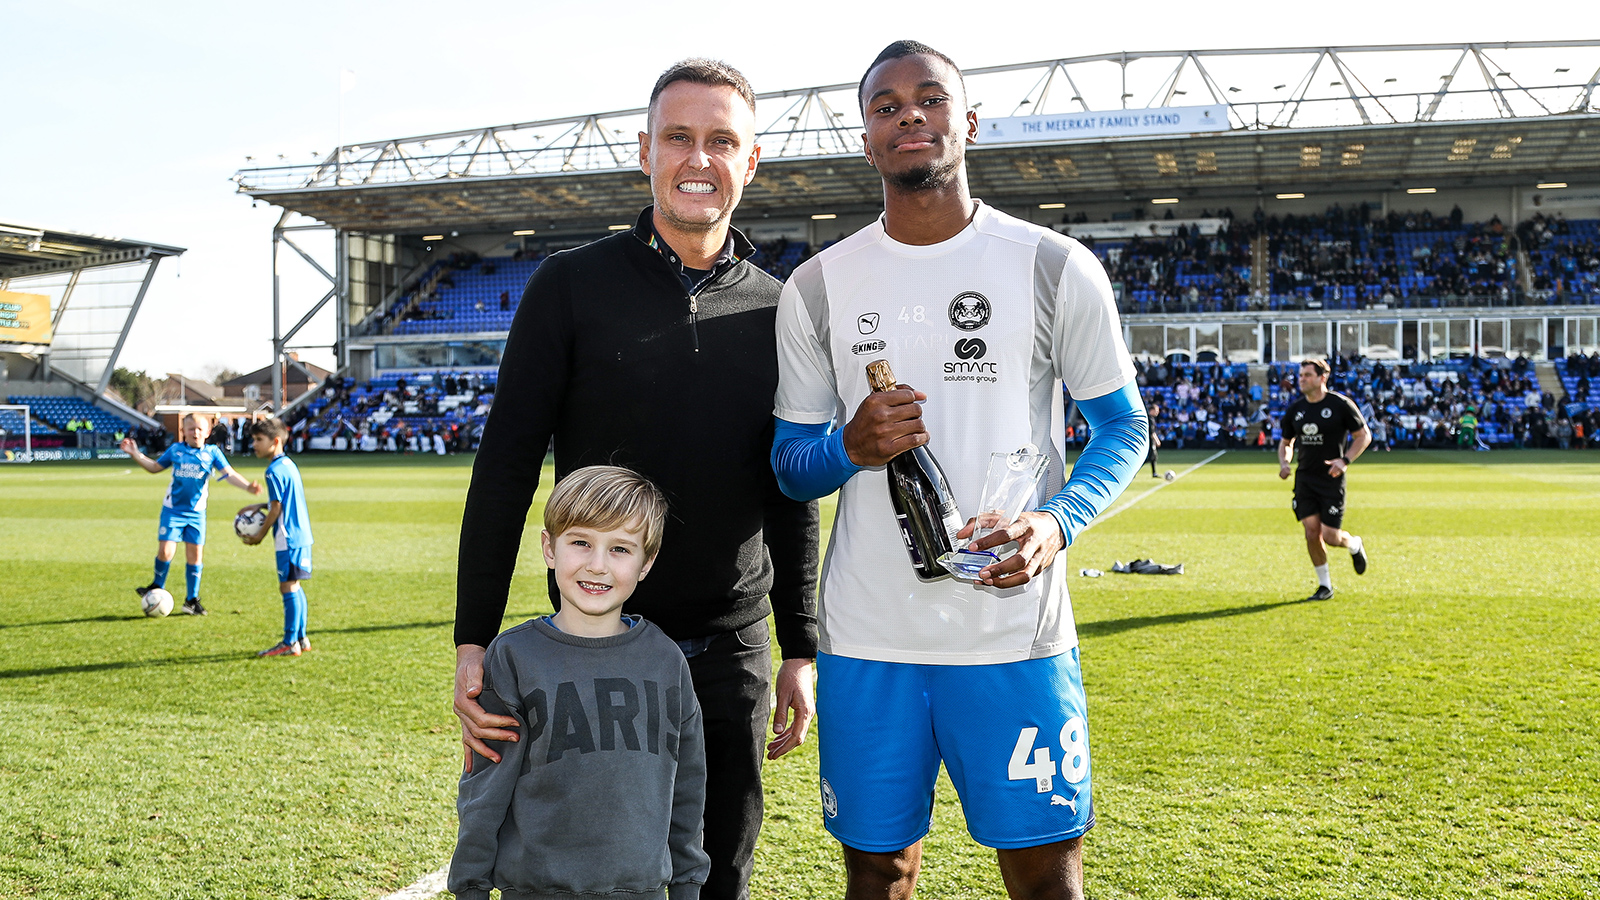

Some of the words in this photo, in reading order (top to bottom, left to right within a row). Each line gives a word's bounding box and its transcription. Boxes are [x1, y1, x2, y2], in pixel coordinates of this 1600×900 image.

[1022, 121, 1041, 133] THE
[1046, 118, 1096, 131] MEERKAT
[1100, 115, 1139, 128] FAMILY
[1144, 113, 1181, 126] STAND
[897, 305, 926, 324] 48
[858, 341, 878, 353] KING
[976, 375, 998, 384] group
[34, 450, 62, 461] REPAIR
[1007, 716, 1088, 794] 48
